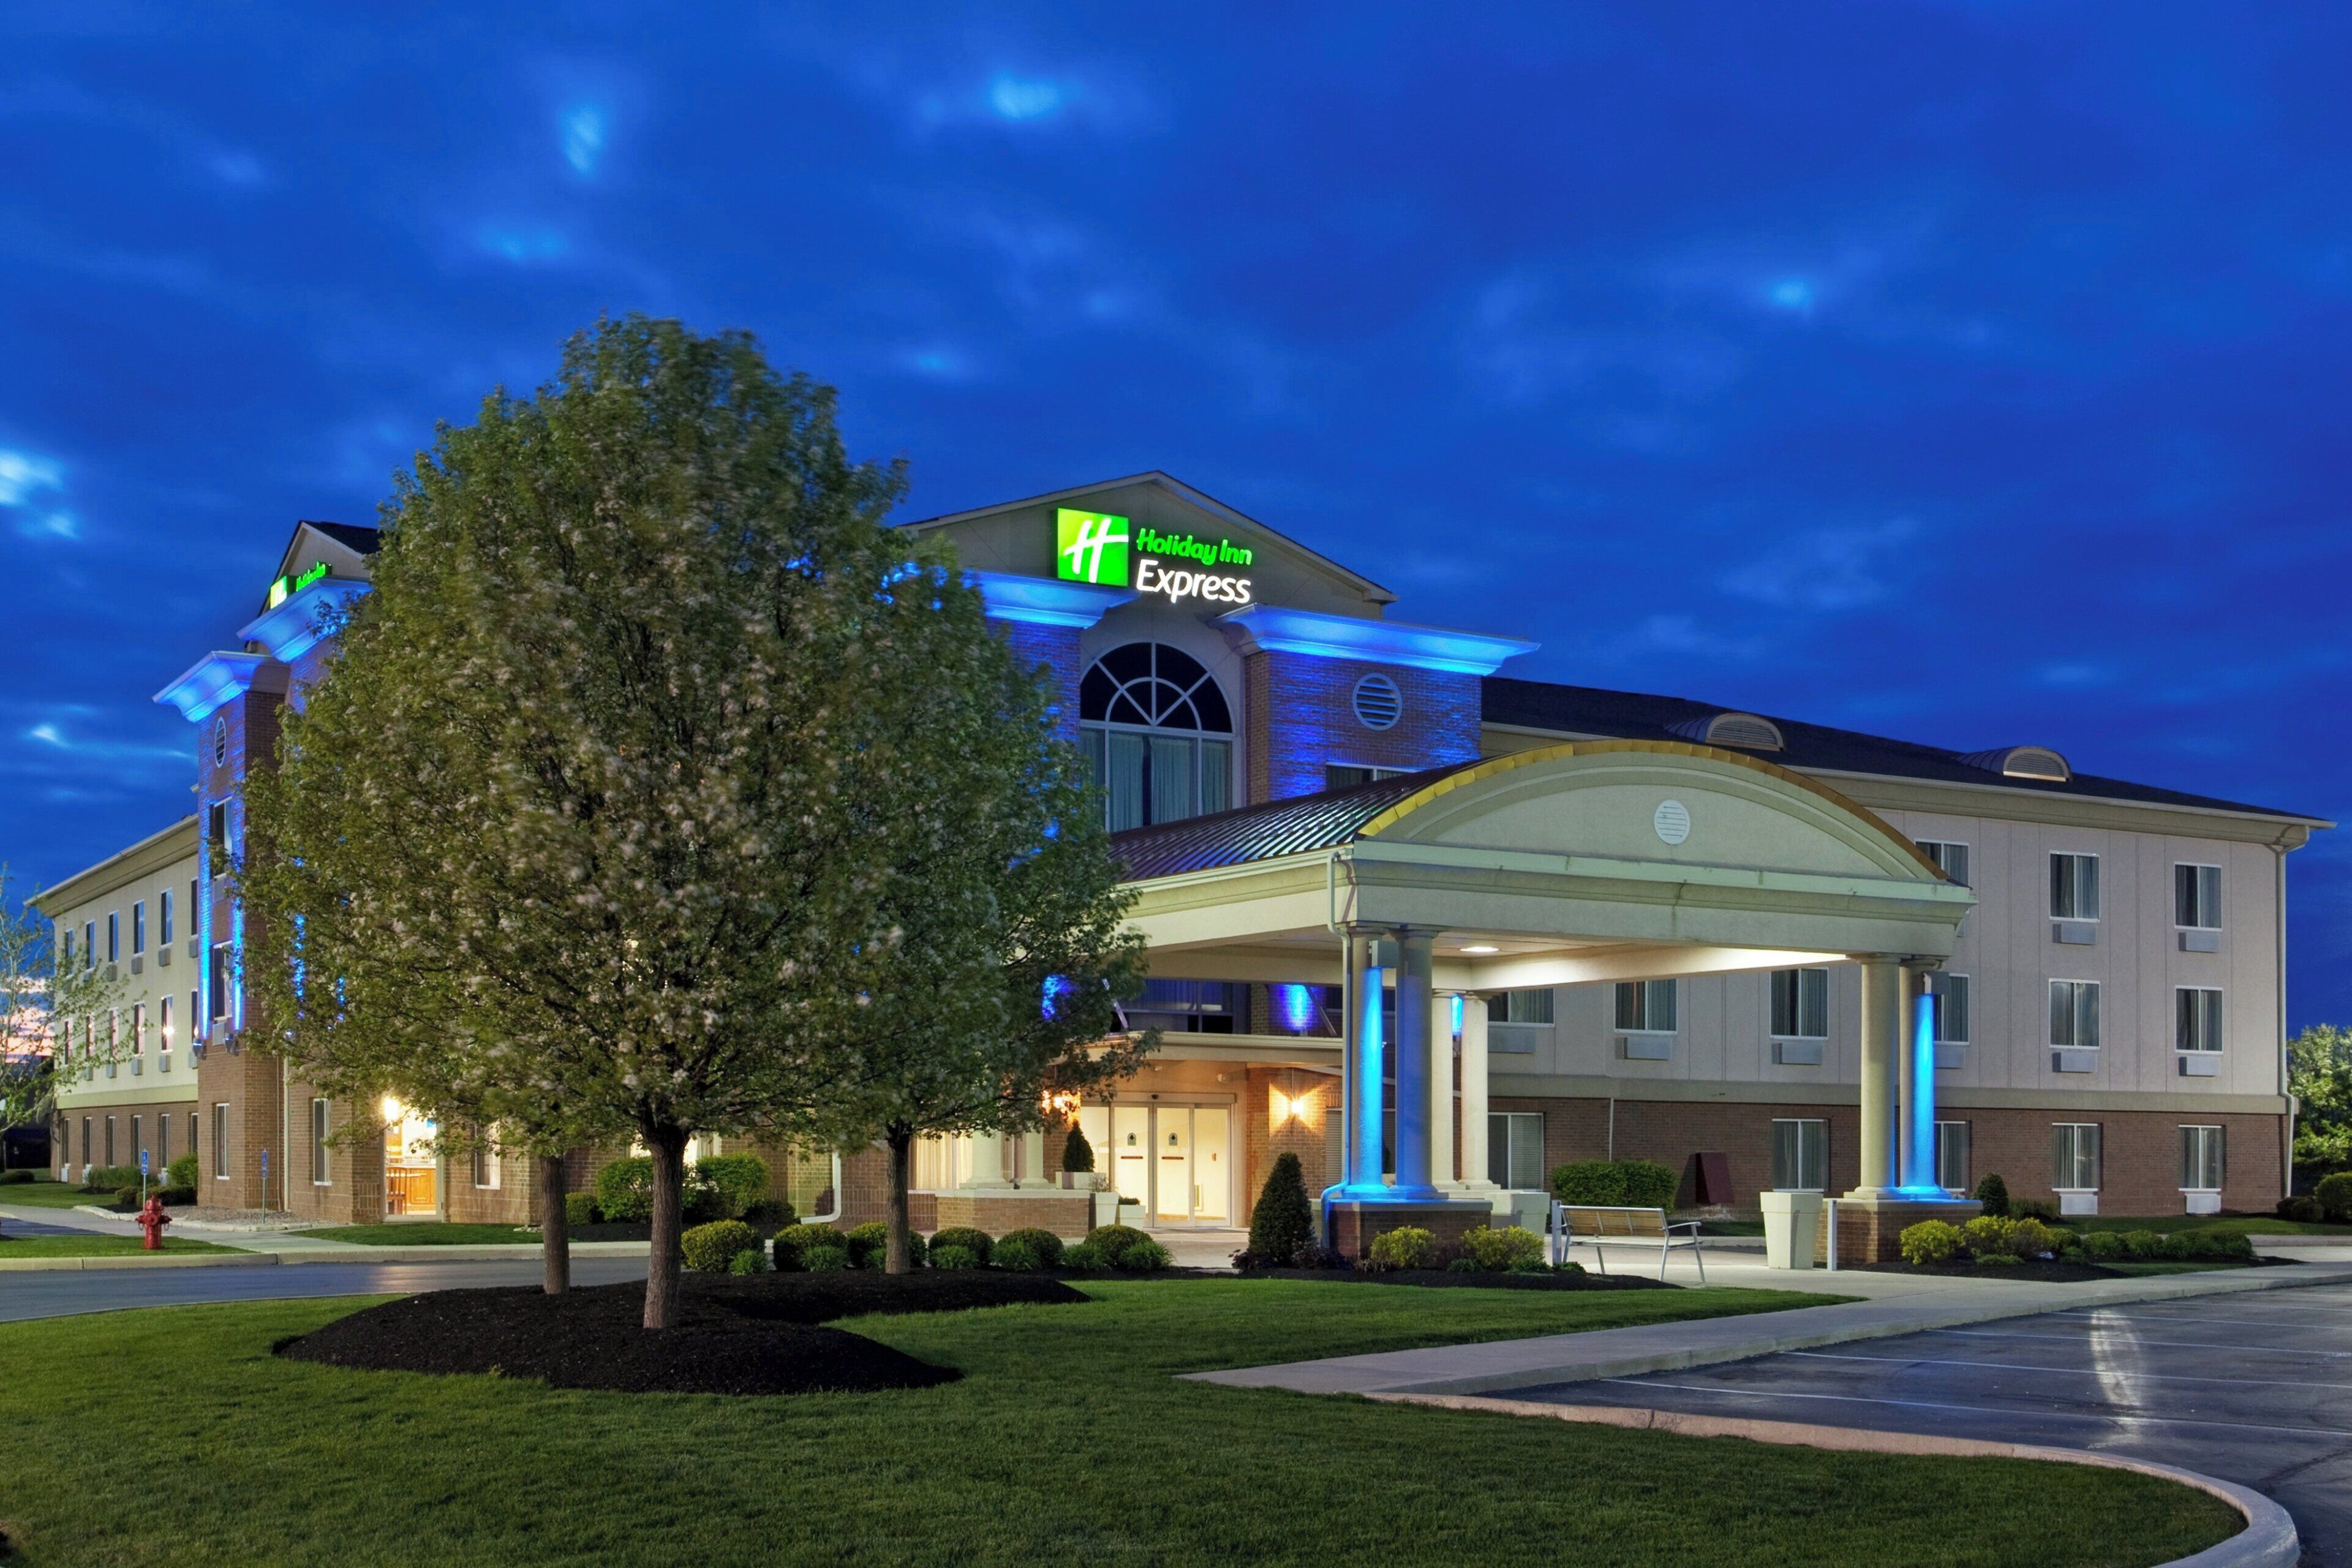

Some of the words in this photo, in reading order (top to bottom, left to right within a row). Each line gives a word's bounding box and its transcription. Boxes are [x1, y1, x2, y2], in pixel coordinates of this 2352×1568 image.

[1136, 528, 1218, 565] Holiday
[1219, 539, 1253, 565] Inn
[1136, 559, 1251, 604] Express
